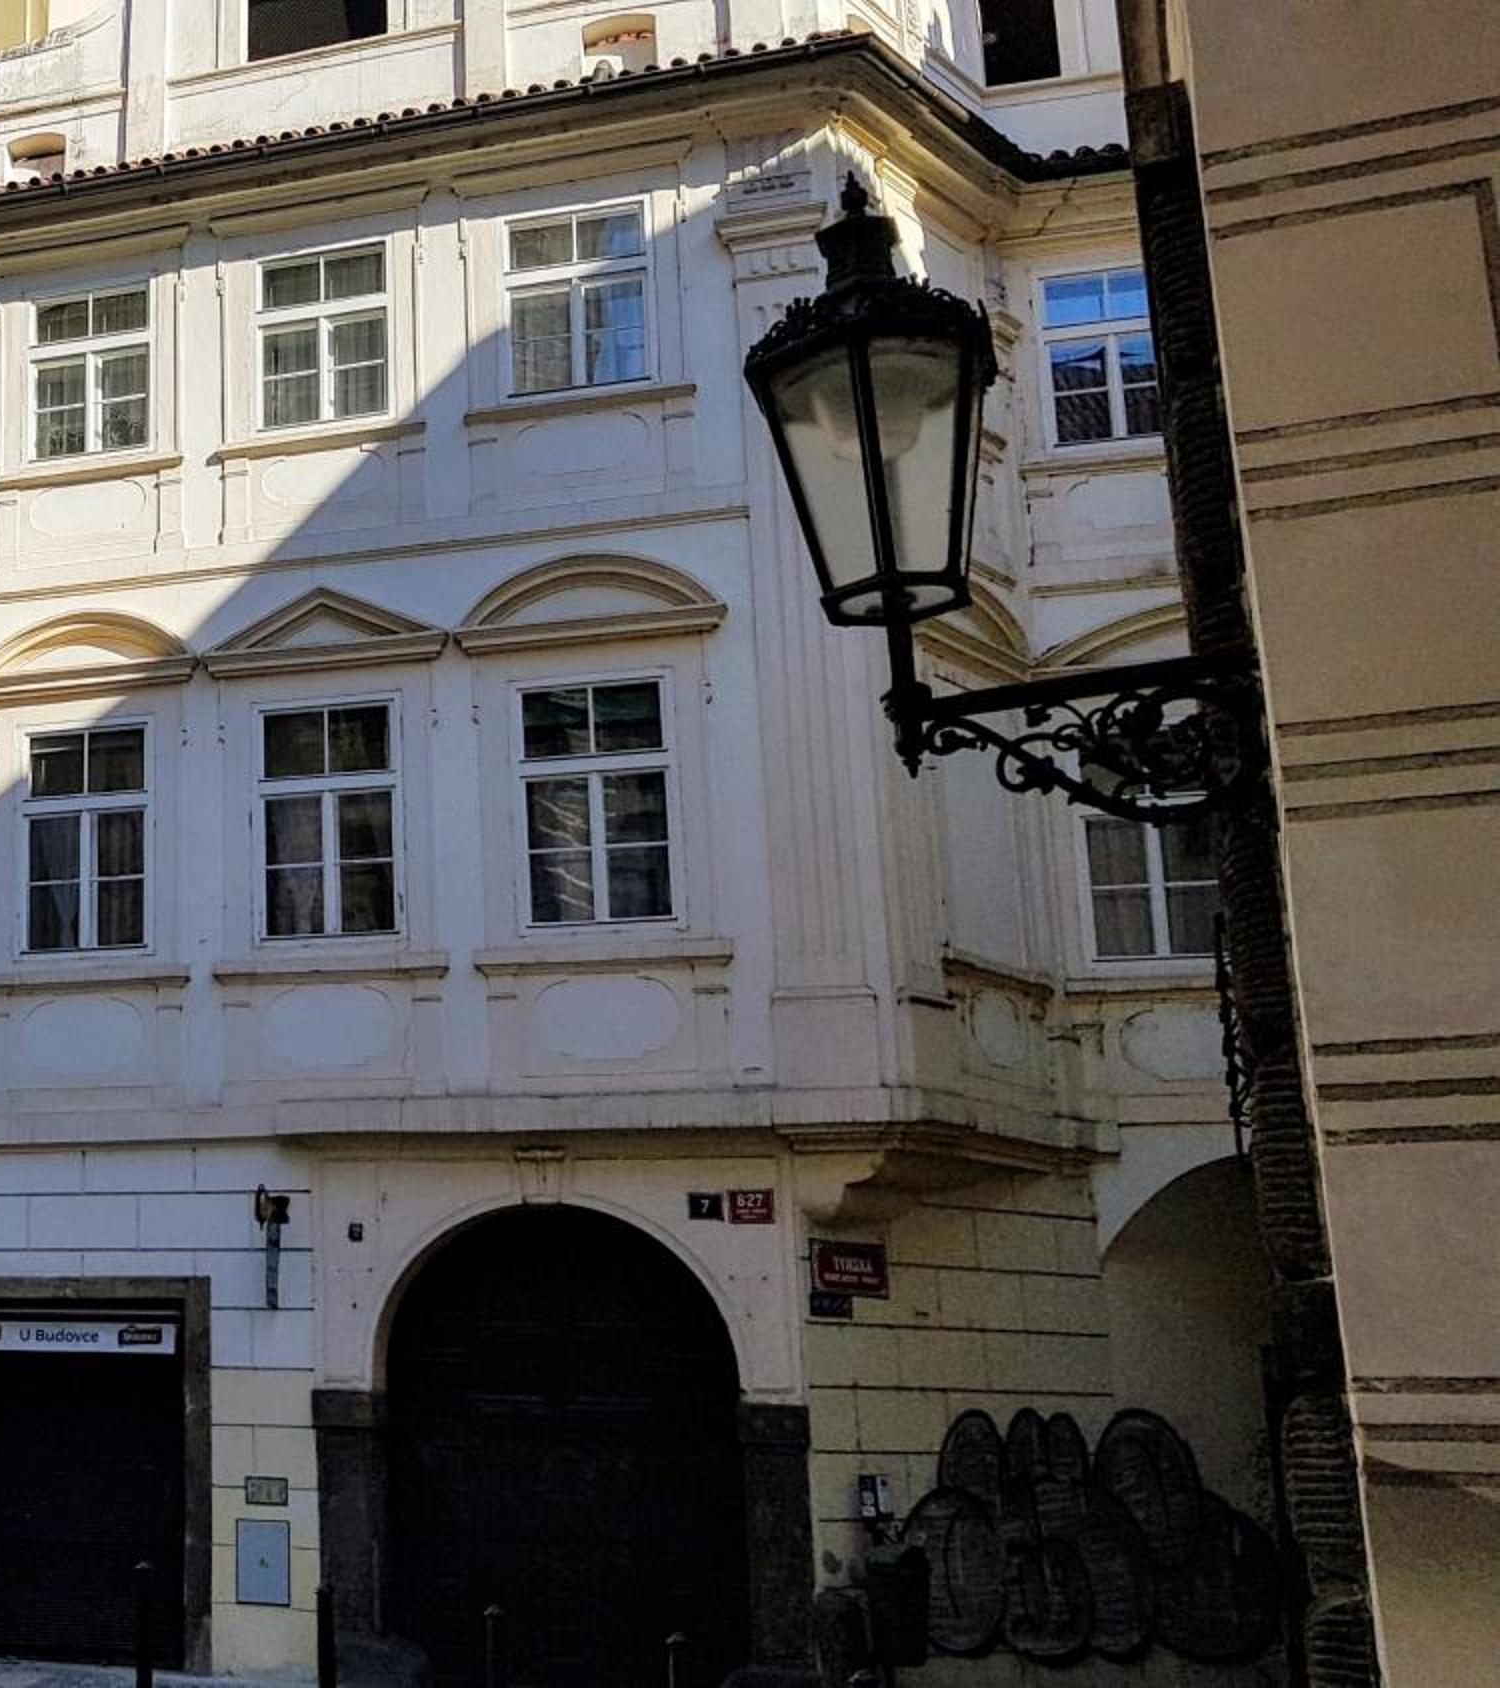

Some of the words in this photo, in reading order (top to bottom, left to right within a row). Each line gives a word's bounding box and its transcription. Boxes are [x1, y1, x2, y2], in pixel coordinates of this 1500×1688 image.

[700, 1198, 710, 1213] 7
[19, 1328, 31, 1342] U
[35, 1328, 99, 1343] Budovce
